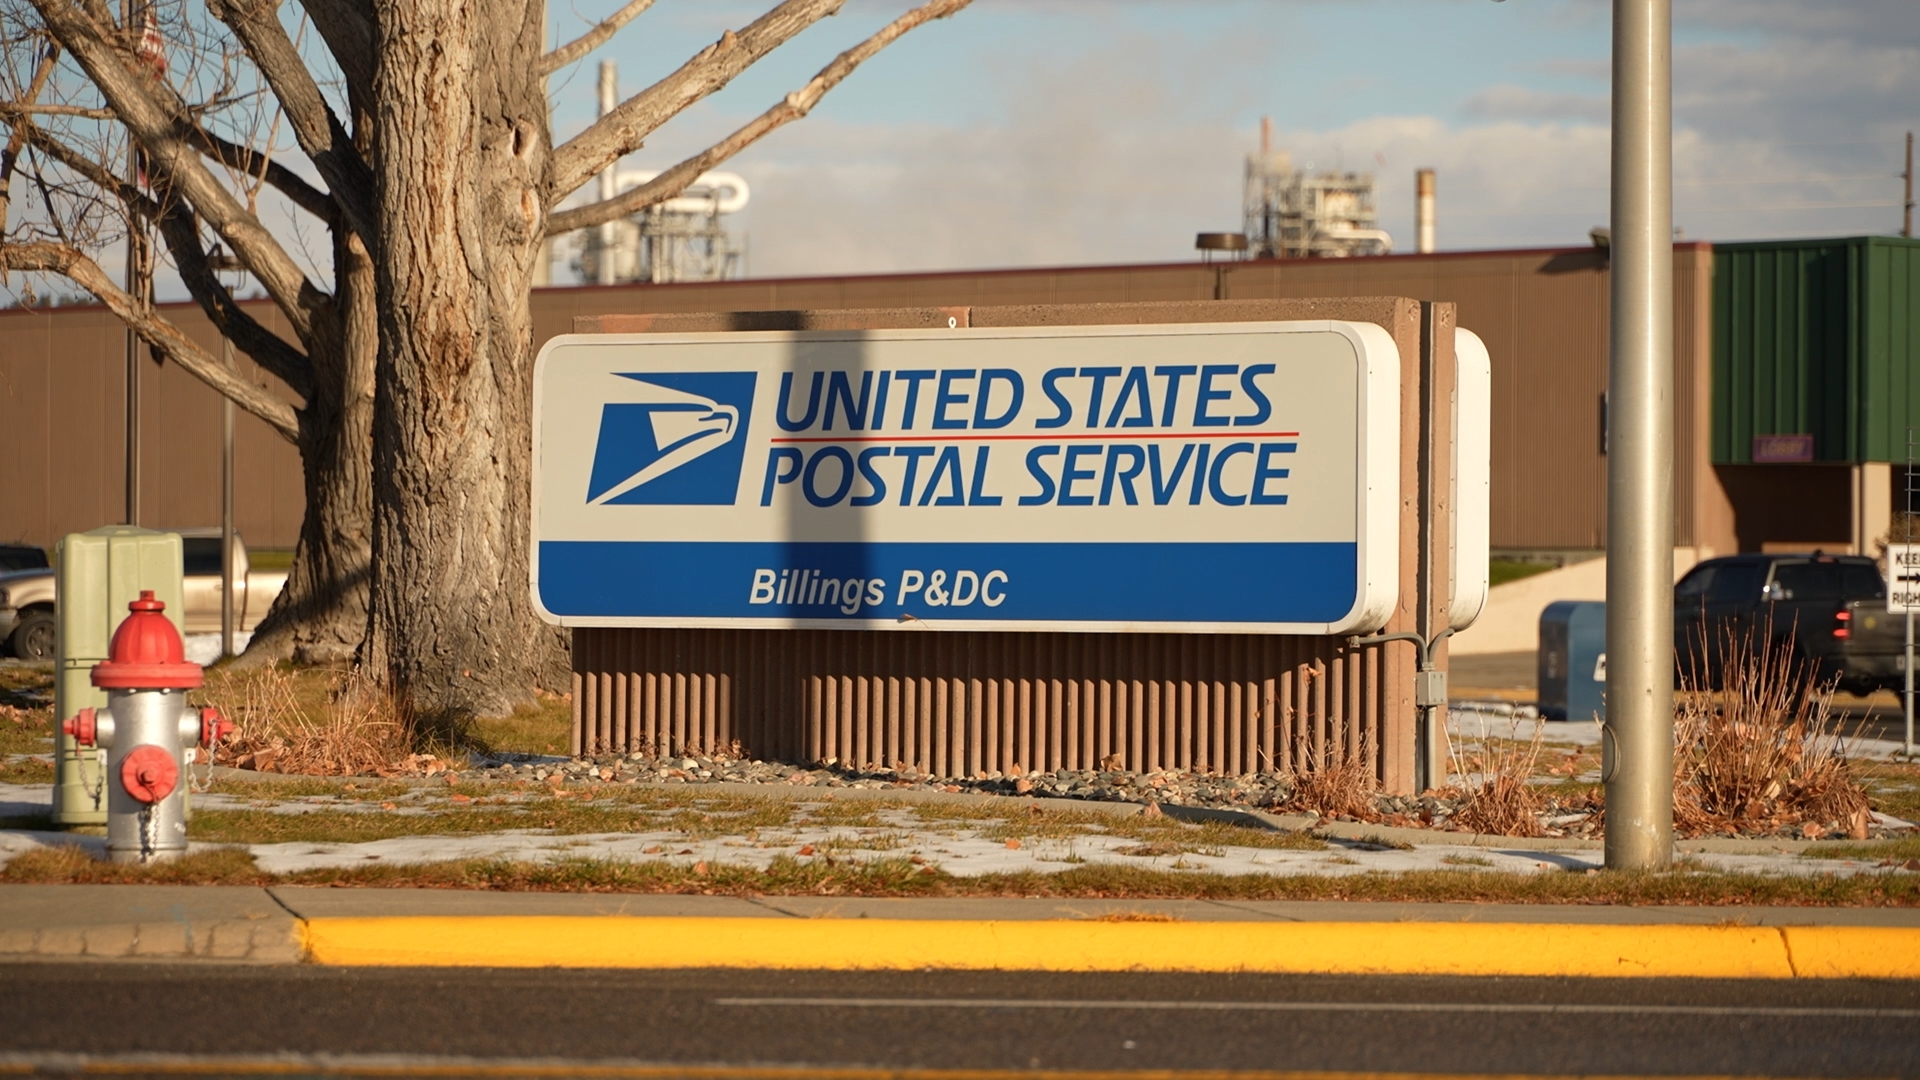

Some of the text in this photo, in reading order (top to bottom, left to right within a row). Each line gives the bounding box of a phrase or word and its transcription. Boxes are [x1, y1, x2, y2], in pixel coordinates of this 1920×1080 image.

[776, 363, 1276, 432] UNITED STATES
[760, 442, 1298, 508] POSTAL SERVICE
[1896, 553, 1920, 565] KEE
[749, 569, 1009, 615] Billings P&DC
